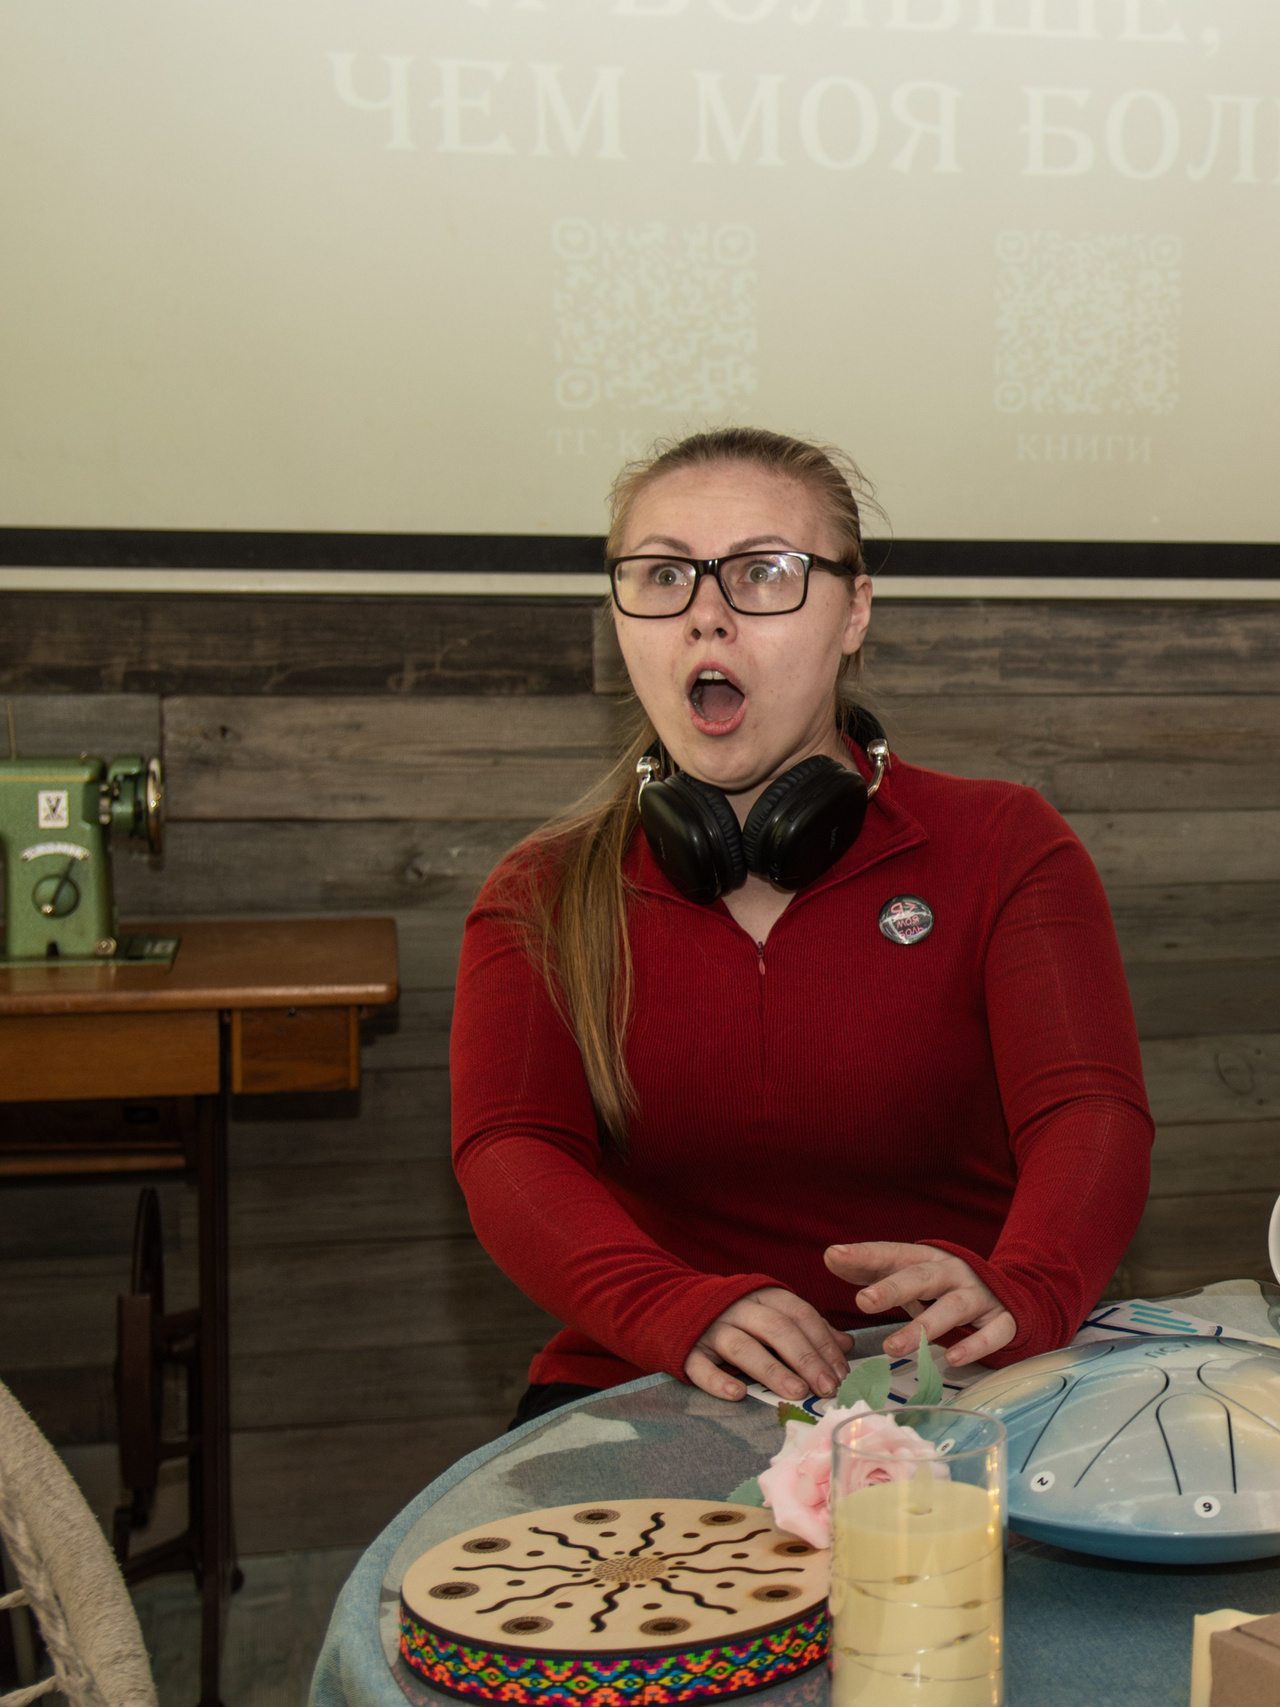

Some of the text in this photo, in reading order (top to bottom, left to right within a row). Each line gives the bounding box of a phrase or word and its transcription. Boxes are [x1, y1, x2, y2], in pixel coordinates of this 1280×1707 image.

[323, 48, 630, 162] ЧЕМ
[689, 68, 963, 175] МОЯ
[1016, 432, 1154, 464] КНИГИ
[896, 914, 920, 929] МОЯ
